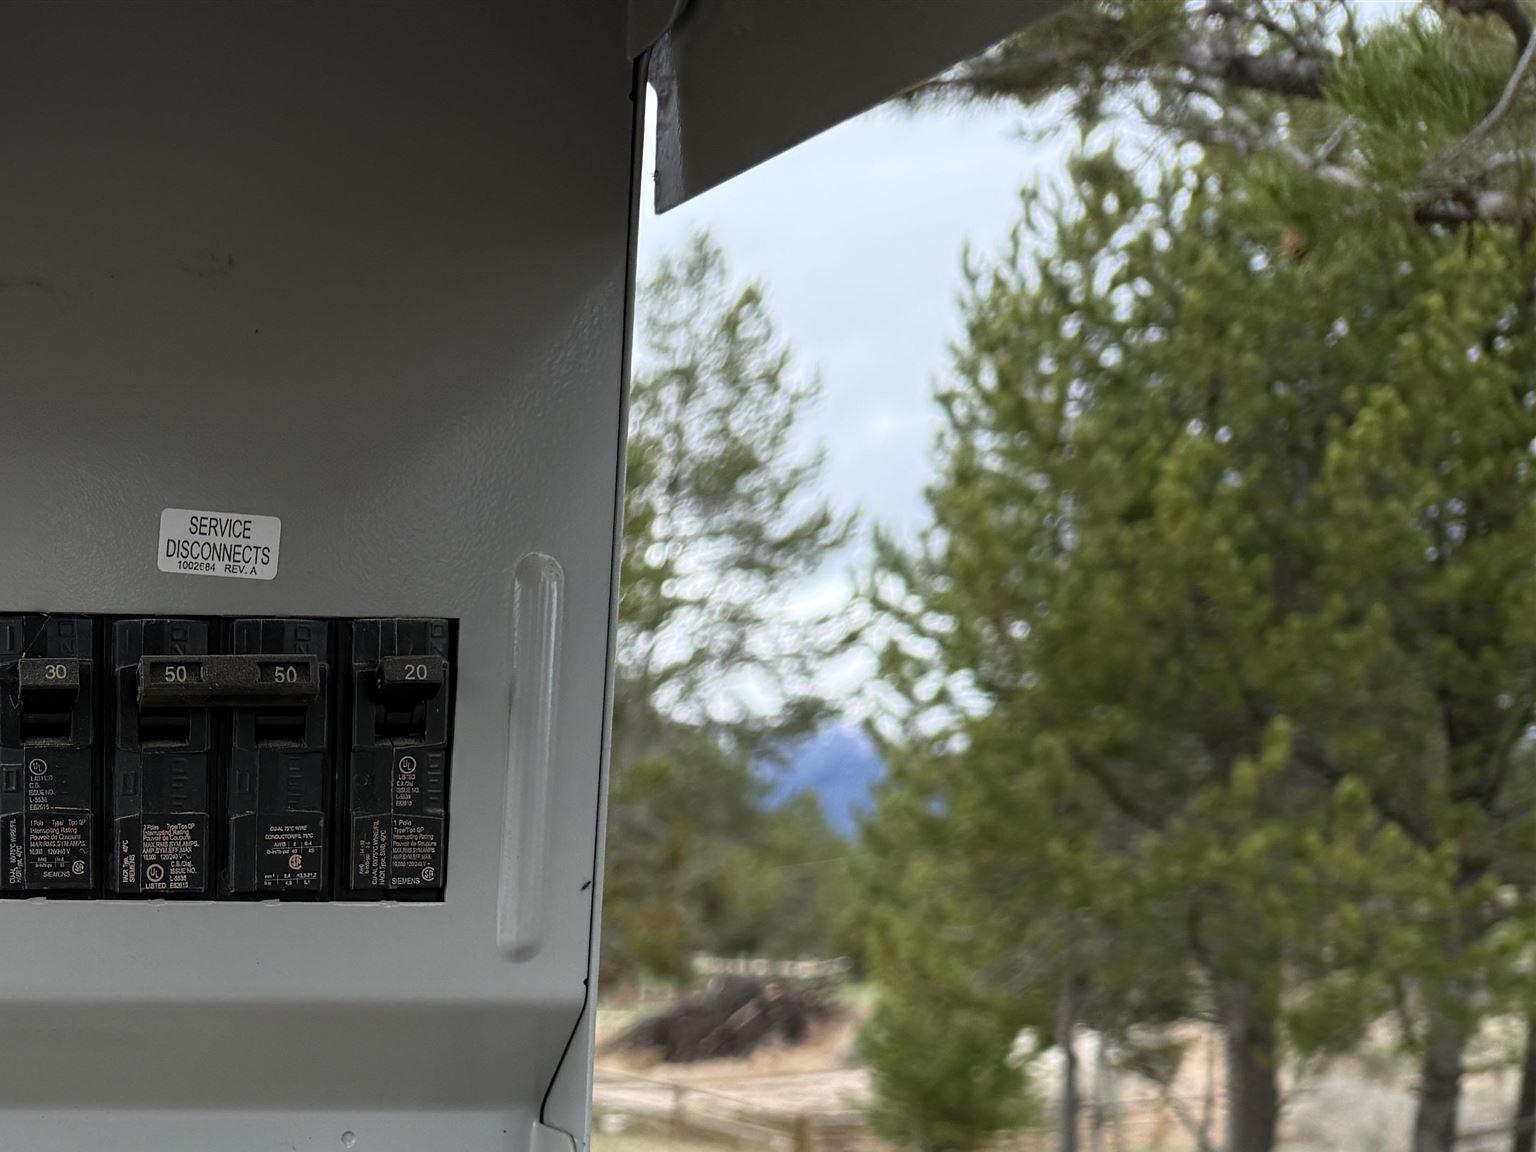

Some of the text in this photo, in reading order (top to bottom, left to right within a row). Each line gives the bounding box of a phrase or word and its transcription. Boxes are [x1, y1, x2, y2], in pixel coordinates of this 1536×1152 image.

[189, 516, 252, 539] SERVICE
[166, 539, 270, 565] DISCONNECTS
[224, 564, 248, 574] REV.
[250, 566, 257, 575] A
[44, 664, 67, 679] 30
[164, 666, 187, 682] 50
[274, 667, 297, 683] 50
[404, 664, 428, 679] 20
